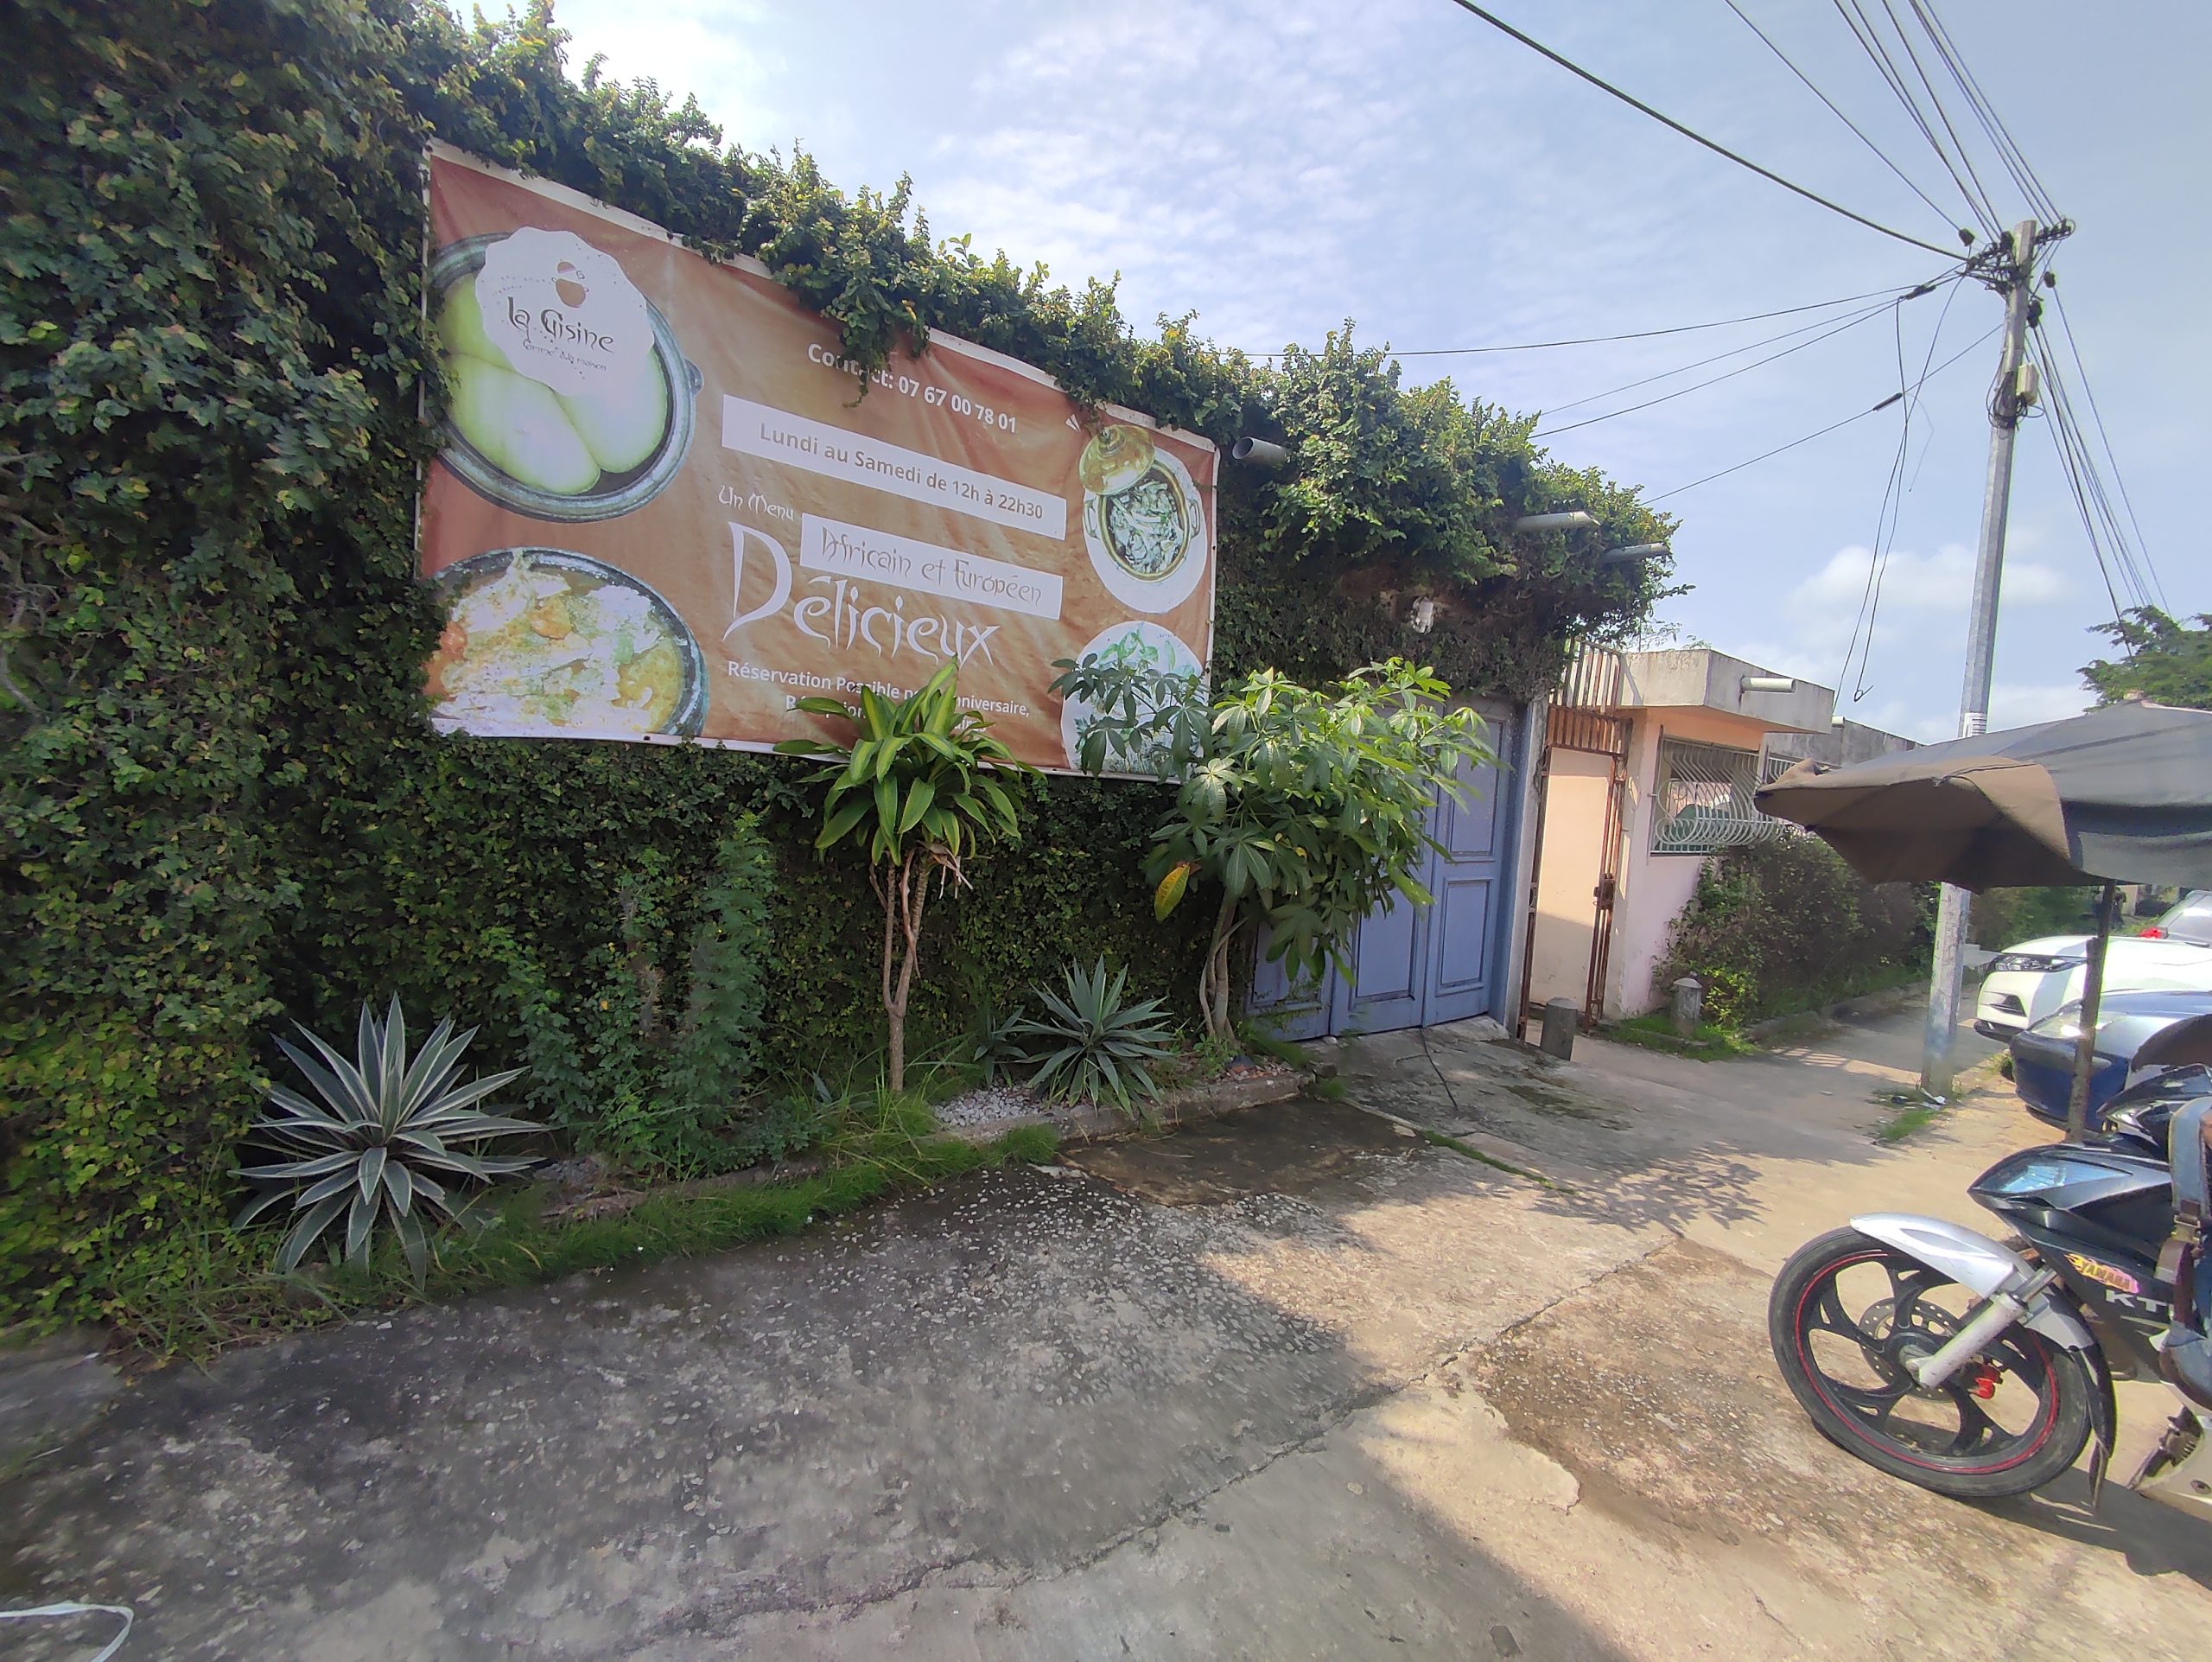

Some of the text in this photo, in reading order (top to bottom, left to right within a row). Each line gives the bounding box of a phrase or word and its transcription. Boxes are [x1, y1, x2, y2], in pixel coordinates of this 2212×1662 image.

[899, 376, 919, 398] 07
[924, 386, 947, 406] 67
[951, 395, 971, 416] 00
[975, 404, 995, 425] 78
[998, 413, 1016, 433] 01
[760, 423, 1044, 519] Lundi au Samedi de 12h à 22h30
[718, 484, 795, 522] Un Menu
[821, 525, 1042, 607] Africain et Européen
[722, 520, 1002, 671] Délicieux
[728, 660, 831, 691] Réservation
[953, 694, 1030, 718] nniversaire,
[2105, 1289, 2175, 1319] KT
